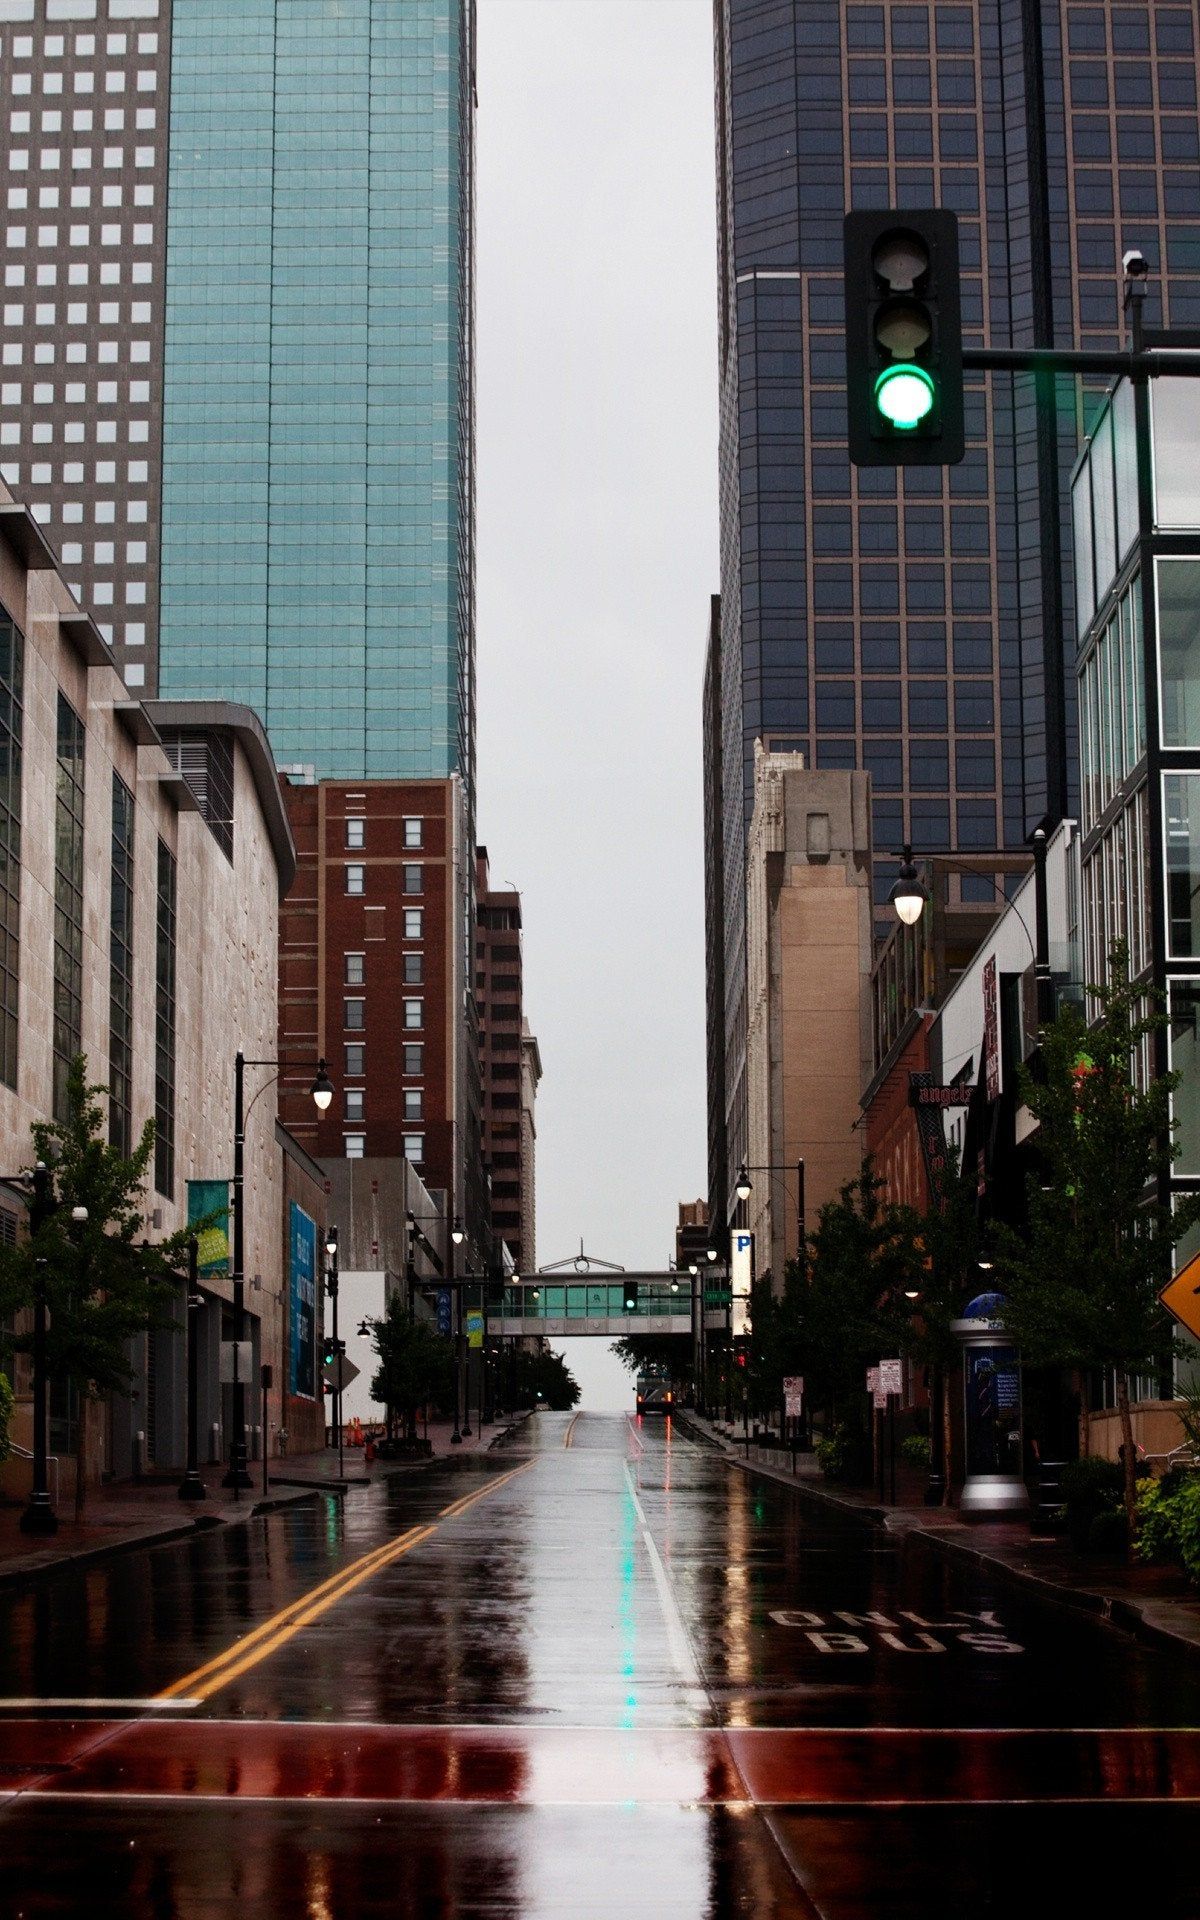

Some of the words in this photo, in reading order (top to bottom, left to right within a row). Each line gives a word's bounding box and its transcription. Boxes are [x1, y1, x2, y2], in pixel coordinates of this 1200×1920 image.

[919, 1081, 973, 1111] angels
[738, 1236, 751, 1251] P
[768, 1610, 1006, 1628] ONLY
[804, 1632, 1026, 1654] BUS
